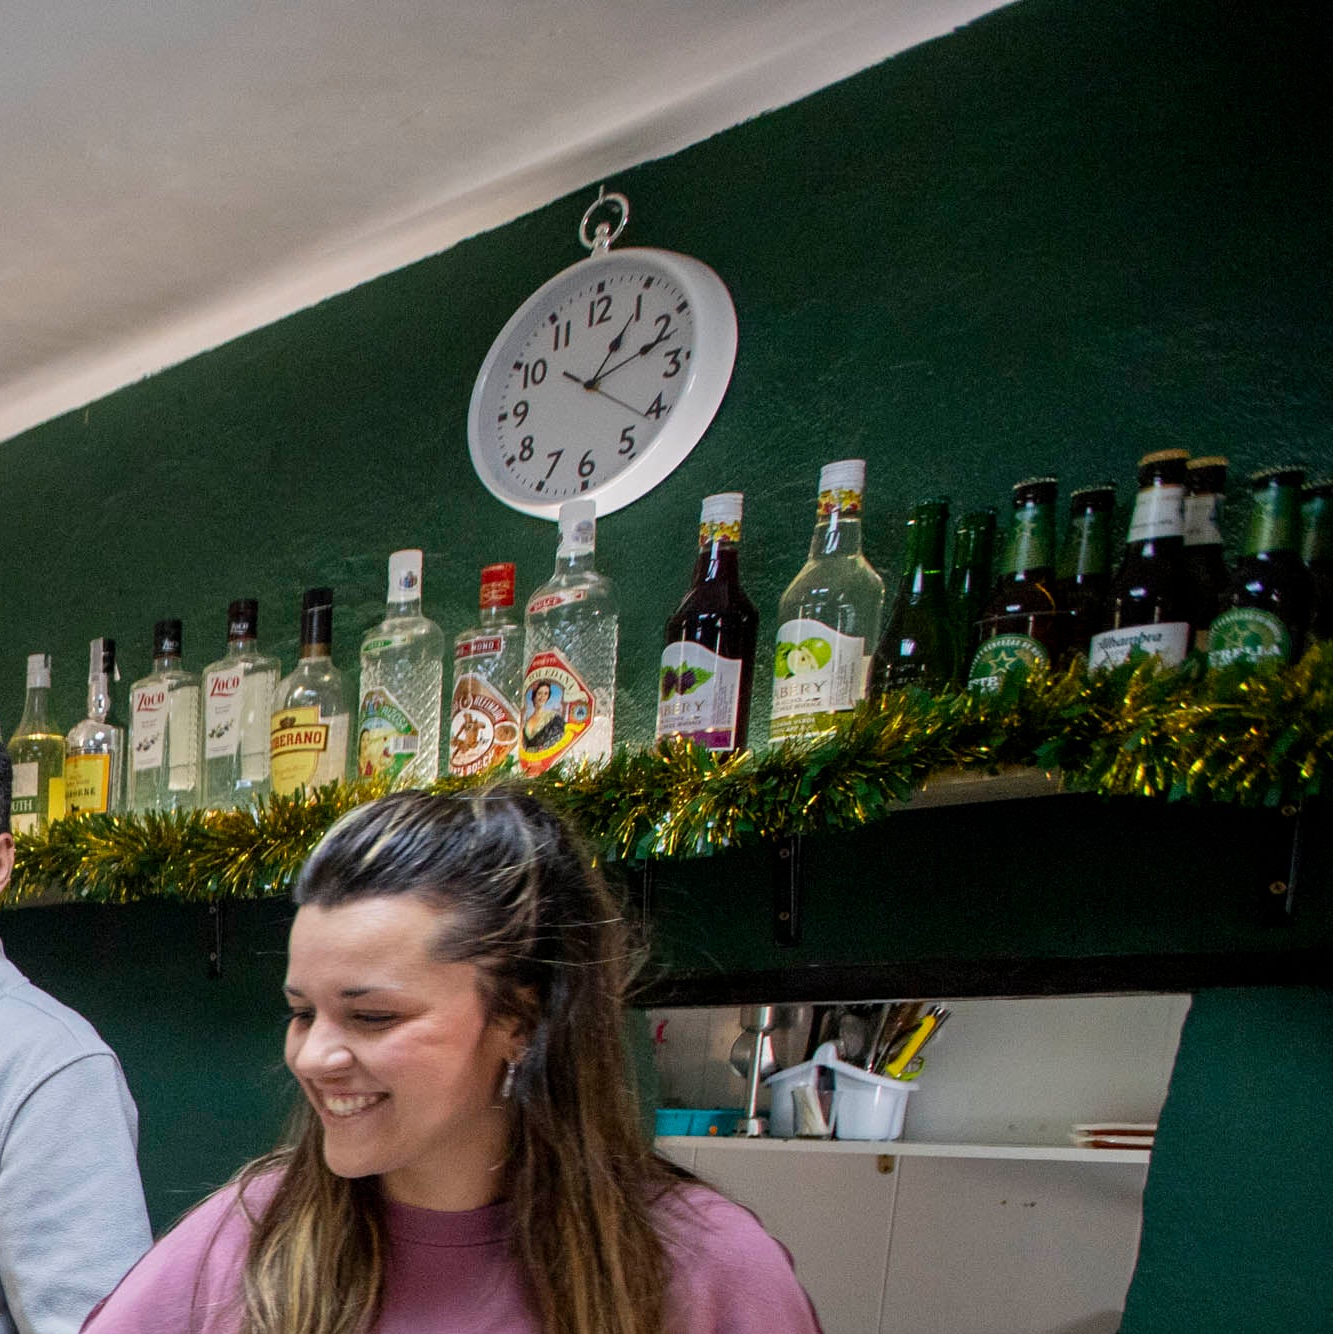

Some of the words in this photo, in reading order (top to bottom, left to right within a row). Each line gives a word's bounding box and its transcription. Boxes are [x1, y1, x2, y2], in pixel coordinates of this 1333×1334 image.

[588, 295, 613, 328] 12
[634, 294, 643, 322] 1
[553, 320, 571, 351] 11
[654, 314, 672, 344] 2
[522, 358, 548, 389] 10
[663, 348, 682, 378] 3
[512, 400, 529, 428] 9
[646, 391, 667, 420] 4
[518, 435, 534, 462] 8
[618, 425, 635, 455] 5
[547, 449, 564, 479] 7
[578, 450, 596, 477] 6
